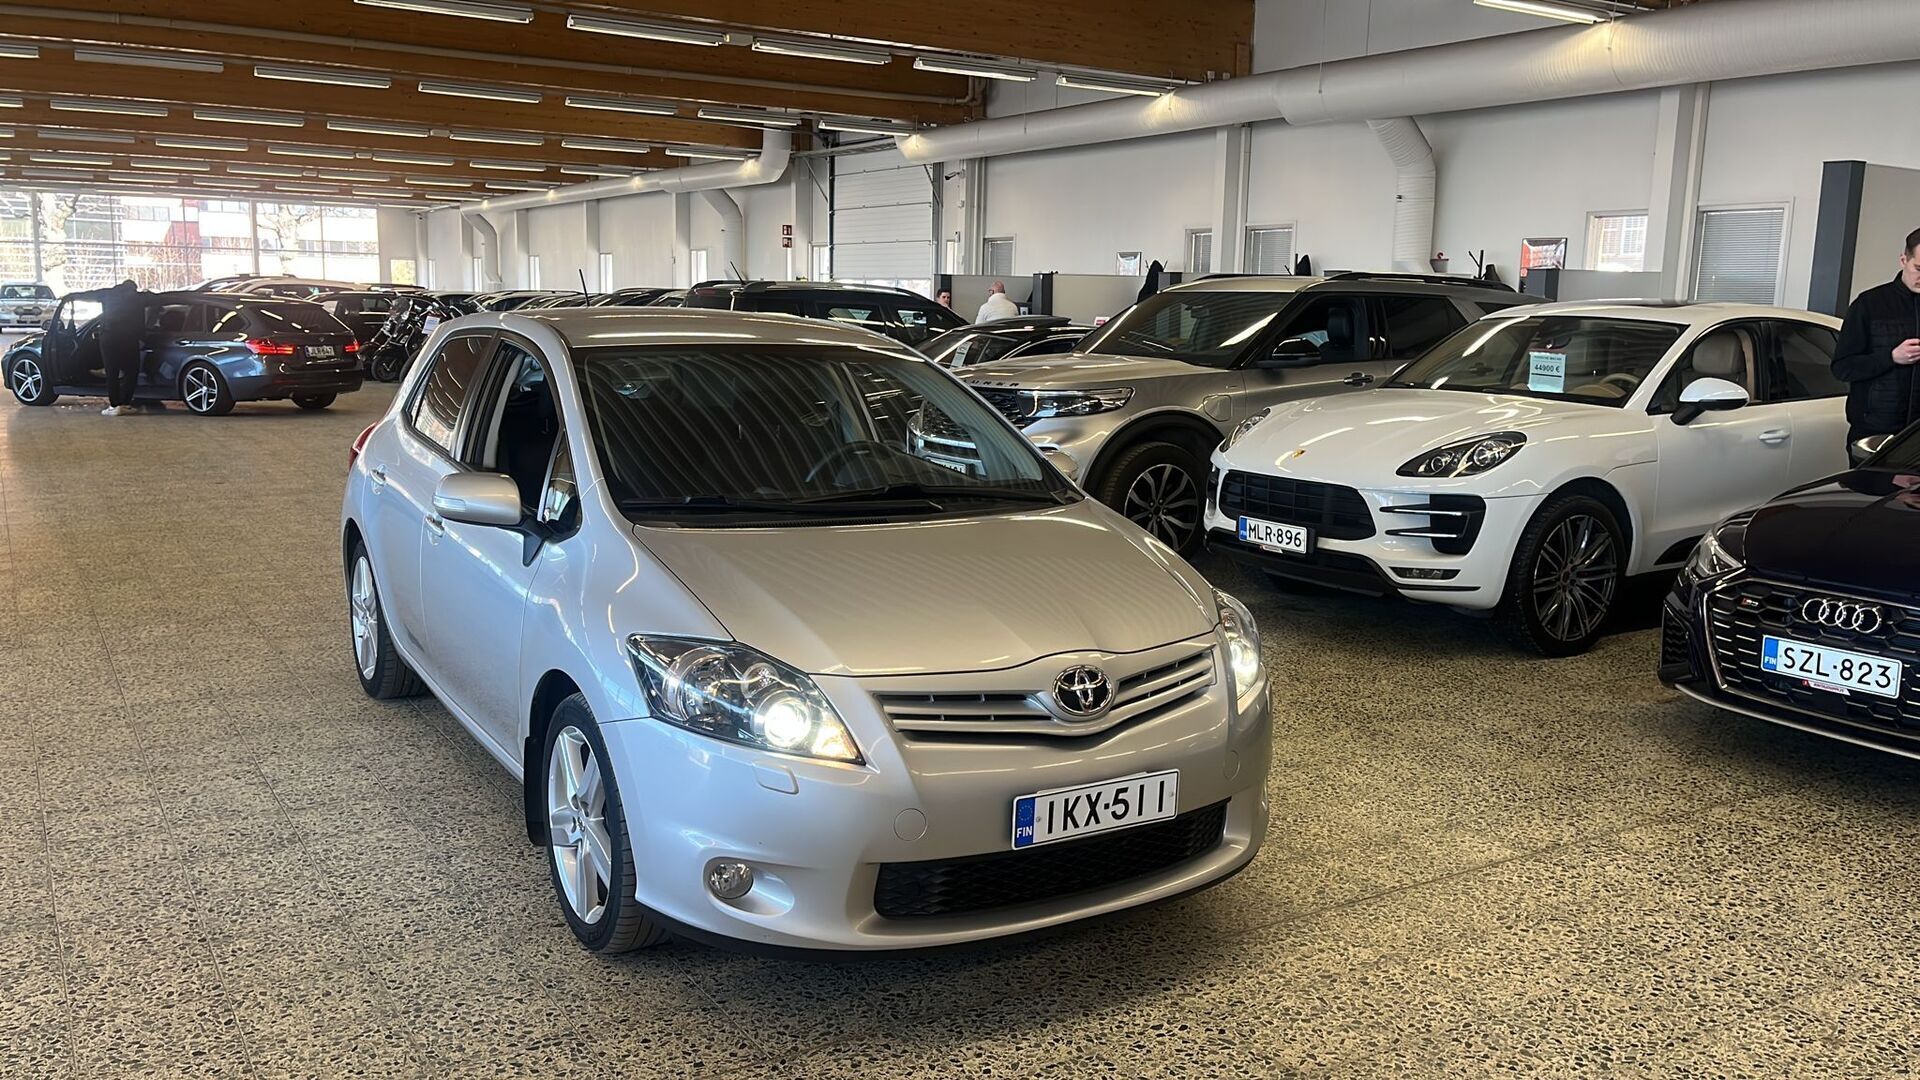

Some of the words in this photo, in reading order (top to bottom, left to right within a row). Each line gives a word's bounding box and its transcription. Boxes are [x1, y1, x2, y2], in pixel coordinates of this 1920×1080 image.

[1534, 364, 1555, 372] 44900
[1555, 365, 1561, 373] €
[1248, 523, 1302, 548] MLR-896
[1764, 656, 1777, 666] FIN
[1783, 647, 1891, 689] SZL-823
[1016, 825, 1033, 838] FIN
[1047, 780, 1165, 834] IKX-511
